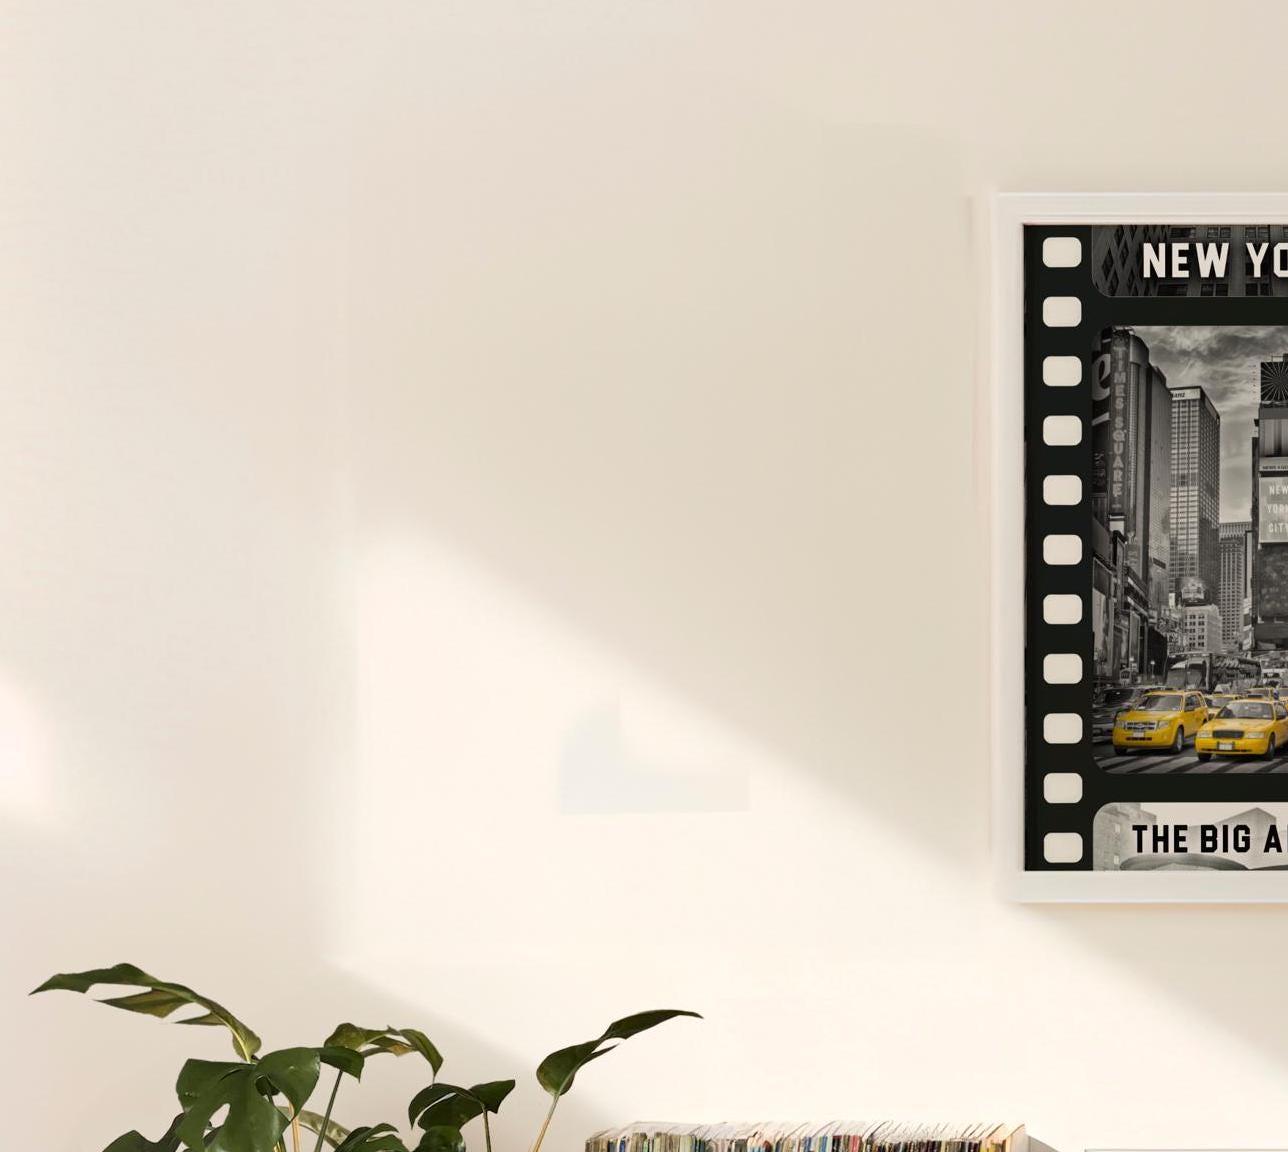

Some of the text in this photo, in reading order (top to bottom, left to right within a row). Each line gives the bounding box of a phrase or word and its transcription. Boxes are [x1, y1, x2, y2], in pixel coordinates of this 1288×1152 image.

[1143, 243, 1229, 279] NEW
[1112, 346, 1126, 411] TIMES
[1269, 485, 1288, 495] NEW
[1133, 825, 1188, 852] THE
[1201, 825, 1251, 852] BIG
